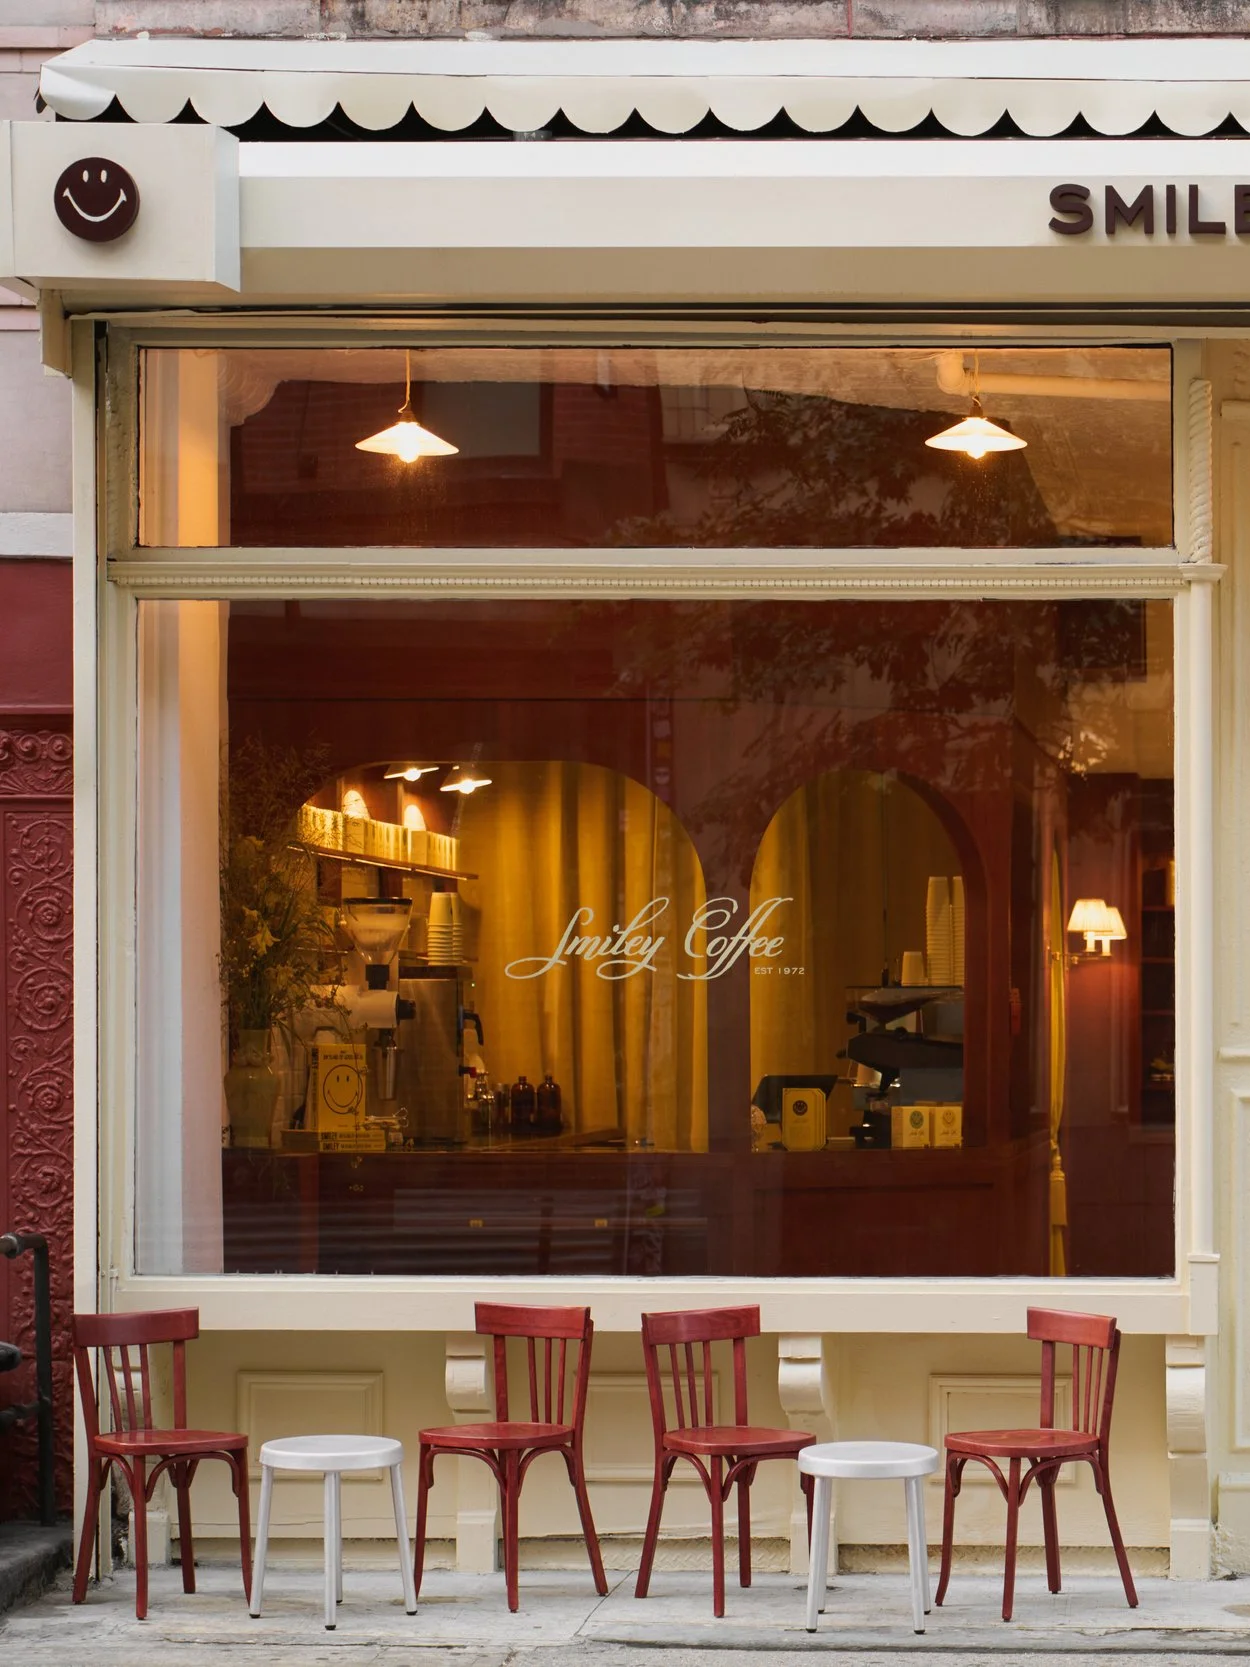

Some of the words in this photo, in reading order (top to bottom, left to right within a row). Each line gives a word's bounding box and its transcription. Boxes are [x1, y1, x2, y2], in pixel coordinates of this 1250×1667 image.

[504, 897, 670, 980] Smiley
[676, 897, 794, 980] Coffee
[754, 967, 774, 975] EST
[777, 967, 805, 975] 1972
